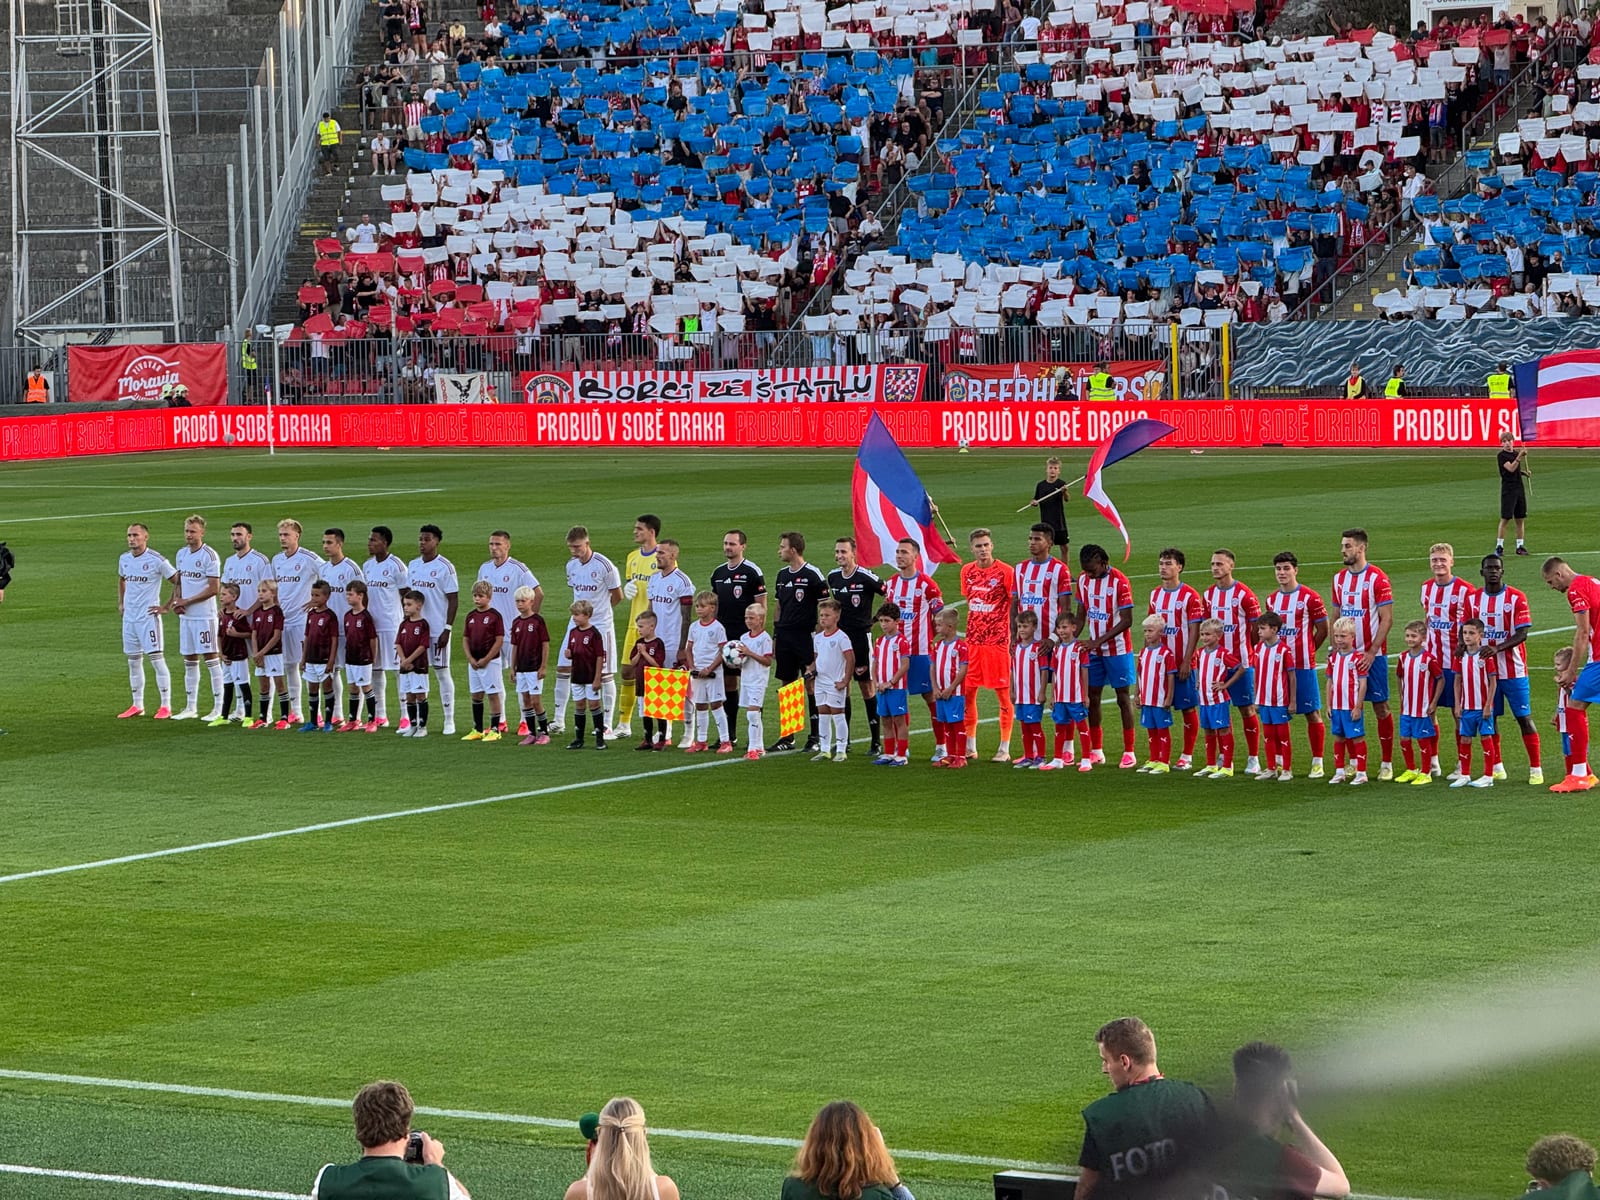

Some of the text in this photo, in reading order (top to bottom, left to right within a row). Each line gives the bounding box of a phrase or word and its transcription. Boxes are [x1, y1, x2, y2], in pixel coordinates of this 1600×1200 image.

[118, 370, 179, 395] Moravia
[579, 378, 692, 401] BORCI
[967, 377, 1146, 401] BEERHNRS
[63, 421, 73, 452] V
[118, 416, 166, 448] DRAKA
[222, 414, 232, 441] V
[280, 413, 332, 442] DRAKA
[408, 412, 421, 442] V
[472, 411, 528, 442] DRAKA
[536, 408, 726, 442] PROBUĎ V SOBĚ DRAKA
[807, 410, 819, 442] V
[875, 410, 932, 442] RAKA
[941, 406, 1013, 442] PROBUĎ
[1018, 410, 1030, 441] V
[1034, 406, 1081, 441] SOBĚ
[1240, 408, 1254, 442] V
[1259, 404, 1310, 442] SOBĚ
[1314, 408, 1381, 442] DRAKA
[1393, 404, 1473, 441] PROBUĎ
[1479, 408, 1492, 441] V
[1498, 408, 1522, 441] SO
[149, 630, 156, 643] 9
[199, 630, 211, 644] 30
